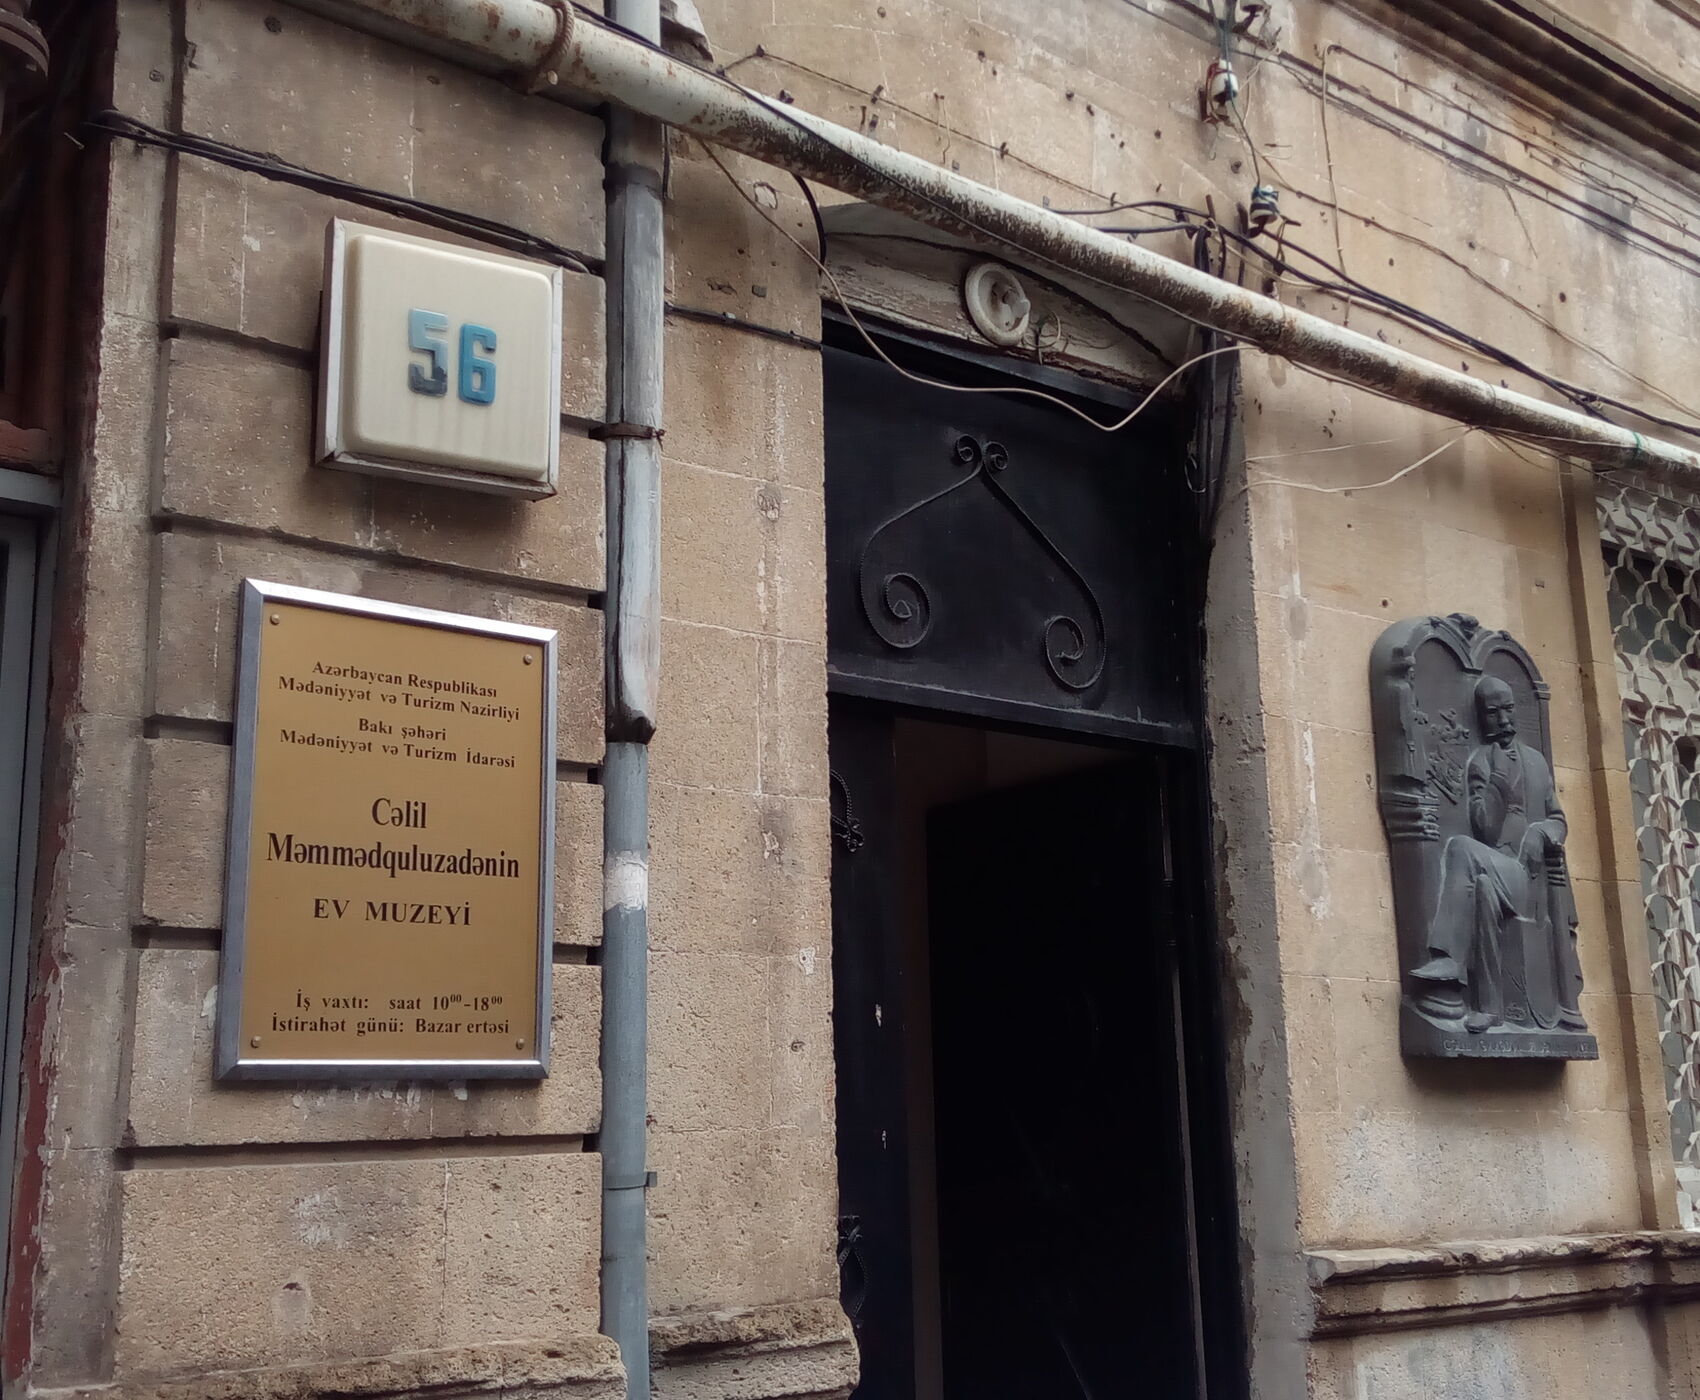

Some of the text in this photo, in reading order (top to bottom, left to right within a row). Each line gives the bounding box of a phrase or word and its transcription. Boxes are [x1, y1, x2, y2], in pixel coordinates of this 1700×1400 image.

[408, 308, 497, 406] 56
[312, 661, 497, 698] Azərbaycan Respublikası
[279, 676, 520, 722] Mədəniyyət və Turizm Nazirliyi
[359, 718, 446, 741] Bakı şəhəri
[280, 729, 515, 768] Mədəniyyət və Turizm İdarəsi
[372, 798, 427, 828] Cəlil
[267, 832, 519, 878] Məmmədquluzadənin
[314, 899, 471, 925] EV MUZEYİ
[296, 989, 311, 1011] İş
[322, 996, 369, 1009] vaxtı:
[389, 997, 421, 1010] saat
[272, 1012, 509, 1036] İstirahət günü: Bazar ertəsi
